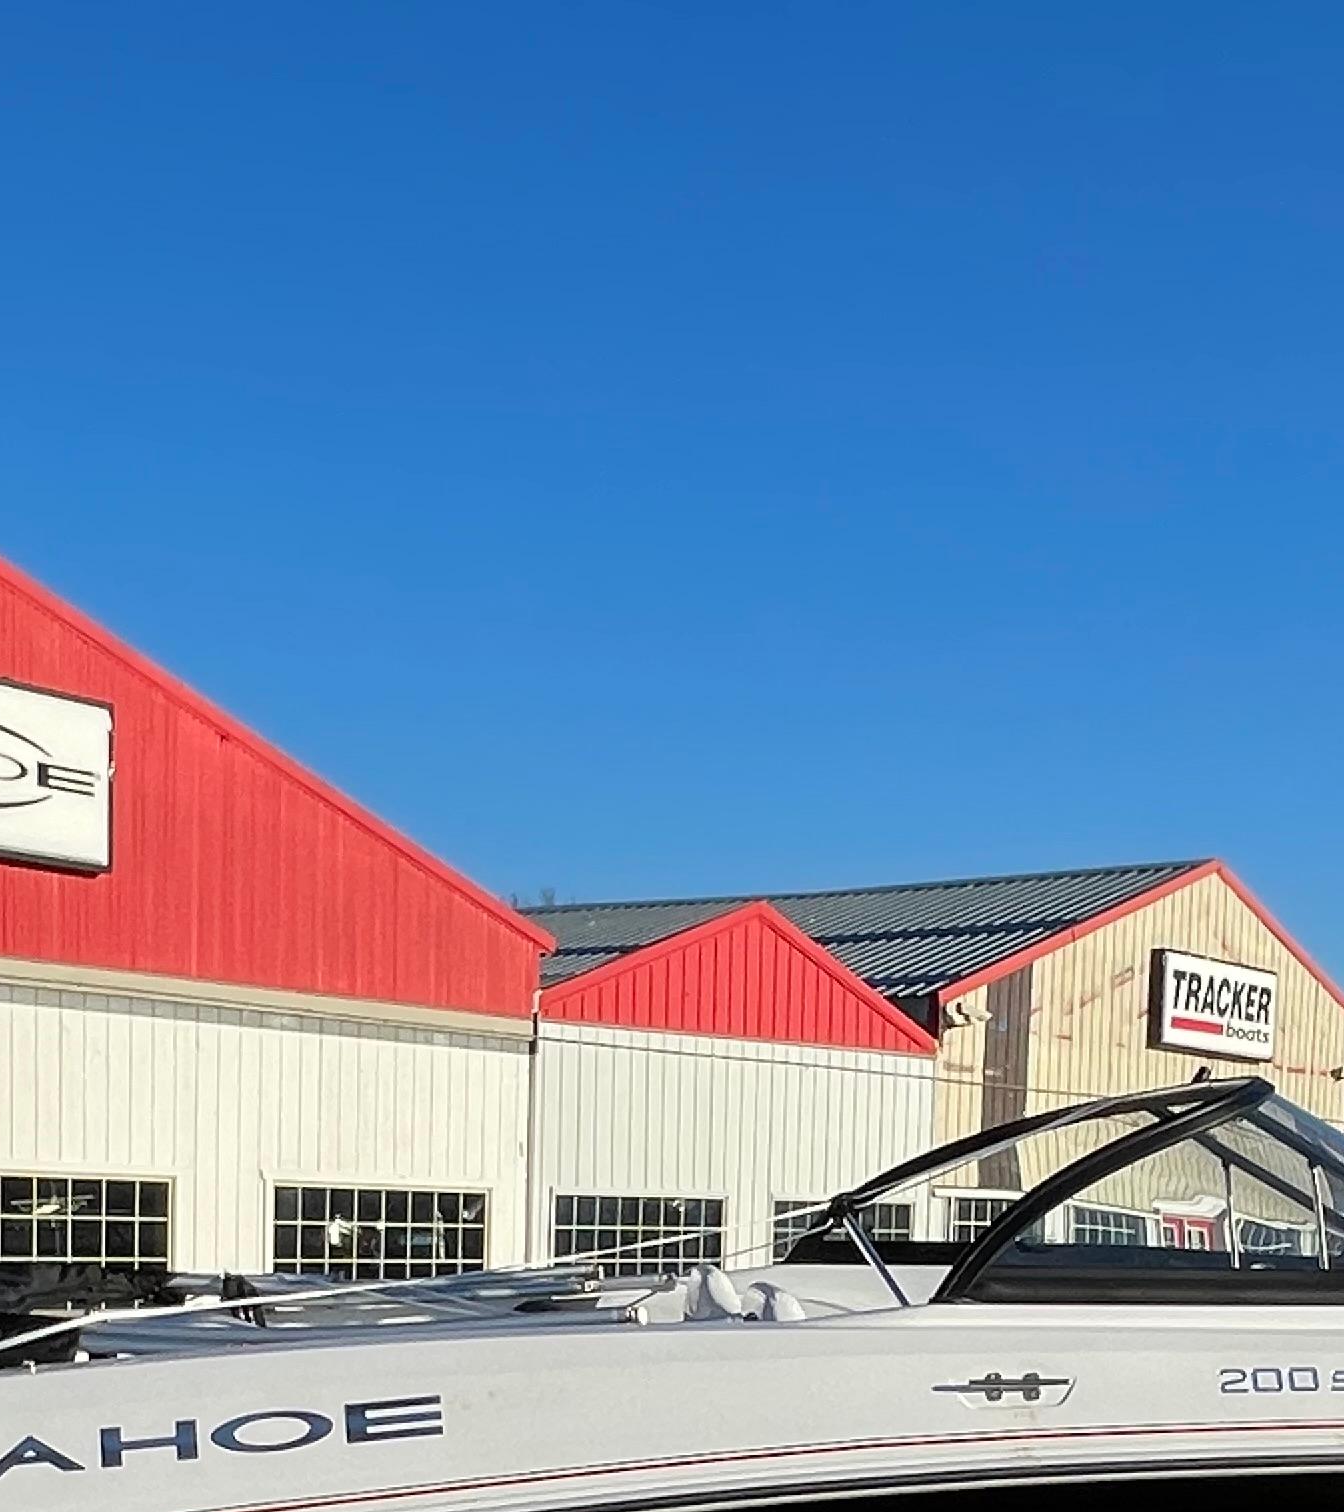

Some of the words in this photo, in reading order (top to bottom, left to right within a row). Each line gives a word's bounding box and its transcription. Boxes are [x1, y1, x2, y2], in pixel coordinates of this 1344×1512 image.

[1173, 969, 1272, 1025] TRACKER
[1225, 1021, 1270, 1043] boats
[1219, 1366, 1320, 1394] 200
